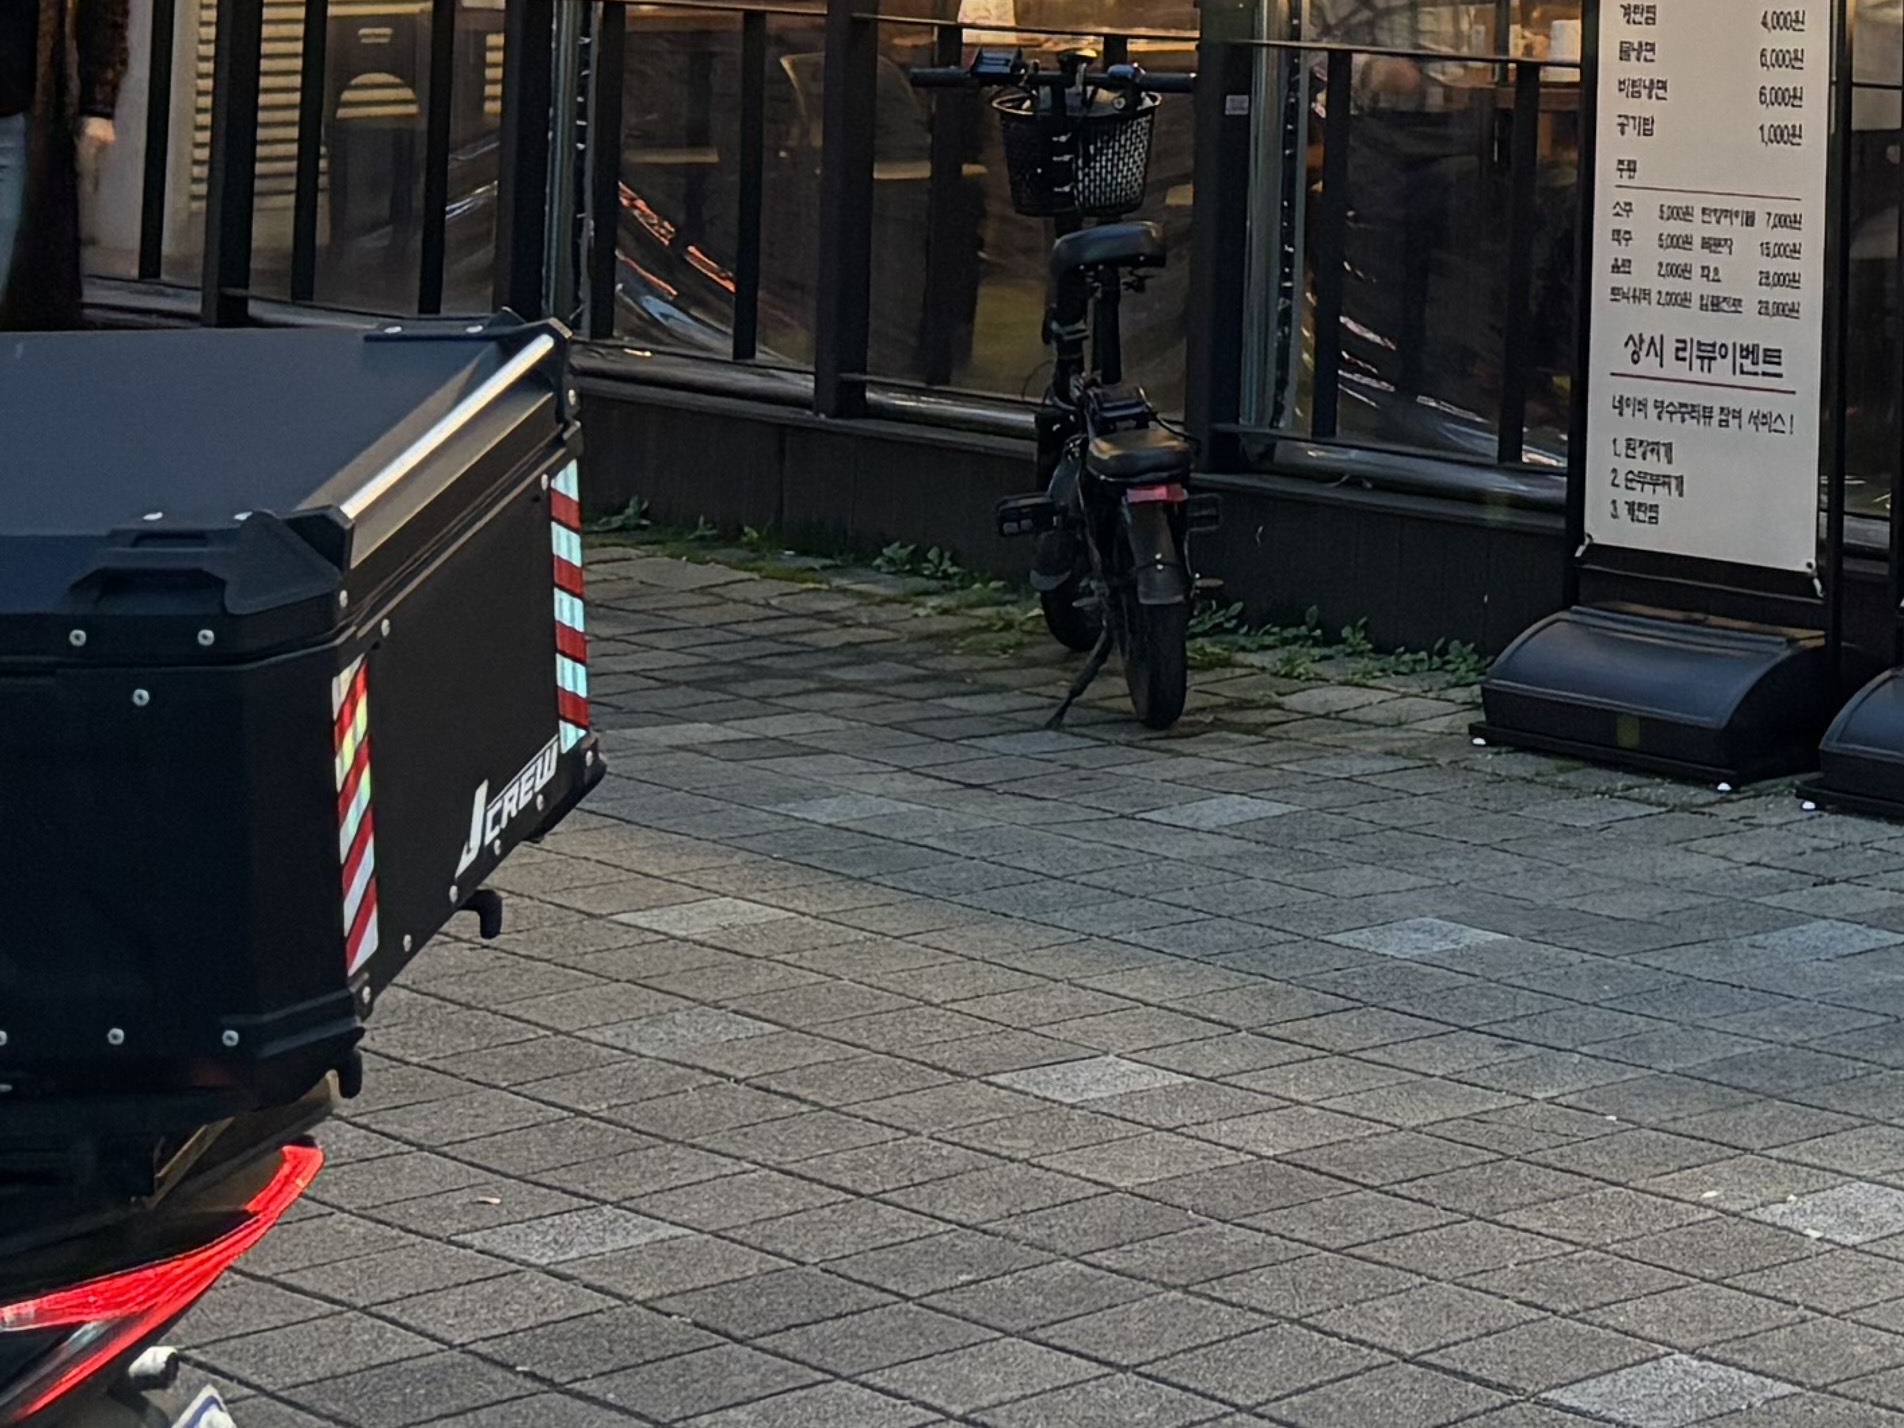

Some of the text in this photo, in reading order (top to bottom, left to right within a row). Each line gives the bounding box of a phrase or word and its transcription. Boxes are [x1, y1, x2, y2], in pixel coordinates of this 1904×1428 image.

[1760, 9, 1806, 33] 4,000원
[1759, 48, 1804, 70] 6,000원
[1617, 77, 1803, 108] 비빔냉면 6,000원
[1616, 114, 1803, 147] 공기밥 1,000원
[1612, 200, 1634, 219] 소주
[1766, 211, 1802, 231] 7,000원
[1611, 228, 1633, 247] 맥주
[1657, 260, 1693, 281] 2,000원
[1656, 289, 1692, 309] 2,000원
[1624, 332, 1784, 379] 상시 리뷰이벤트
[1612, 394, 1649, 420] 네이버
[1653, 398, 1715, 428] 영수증리뷰
[1718, 405, 1742, 432] 참여
[1625, 437, 1673, 466] 된장찌개
[1624, 469, 1684, 498] 순두부찌개
